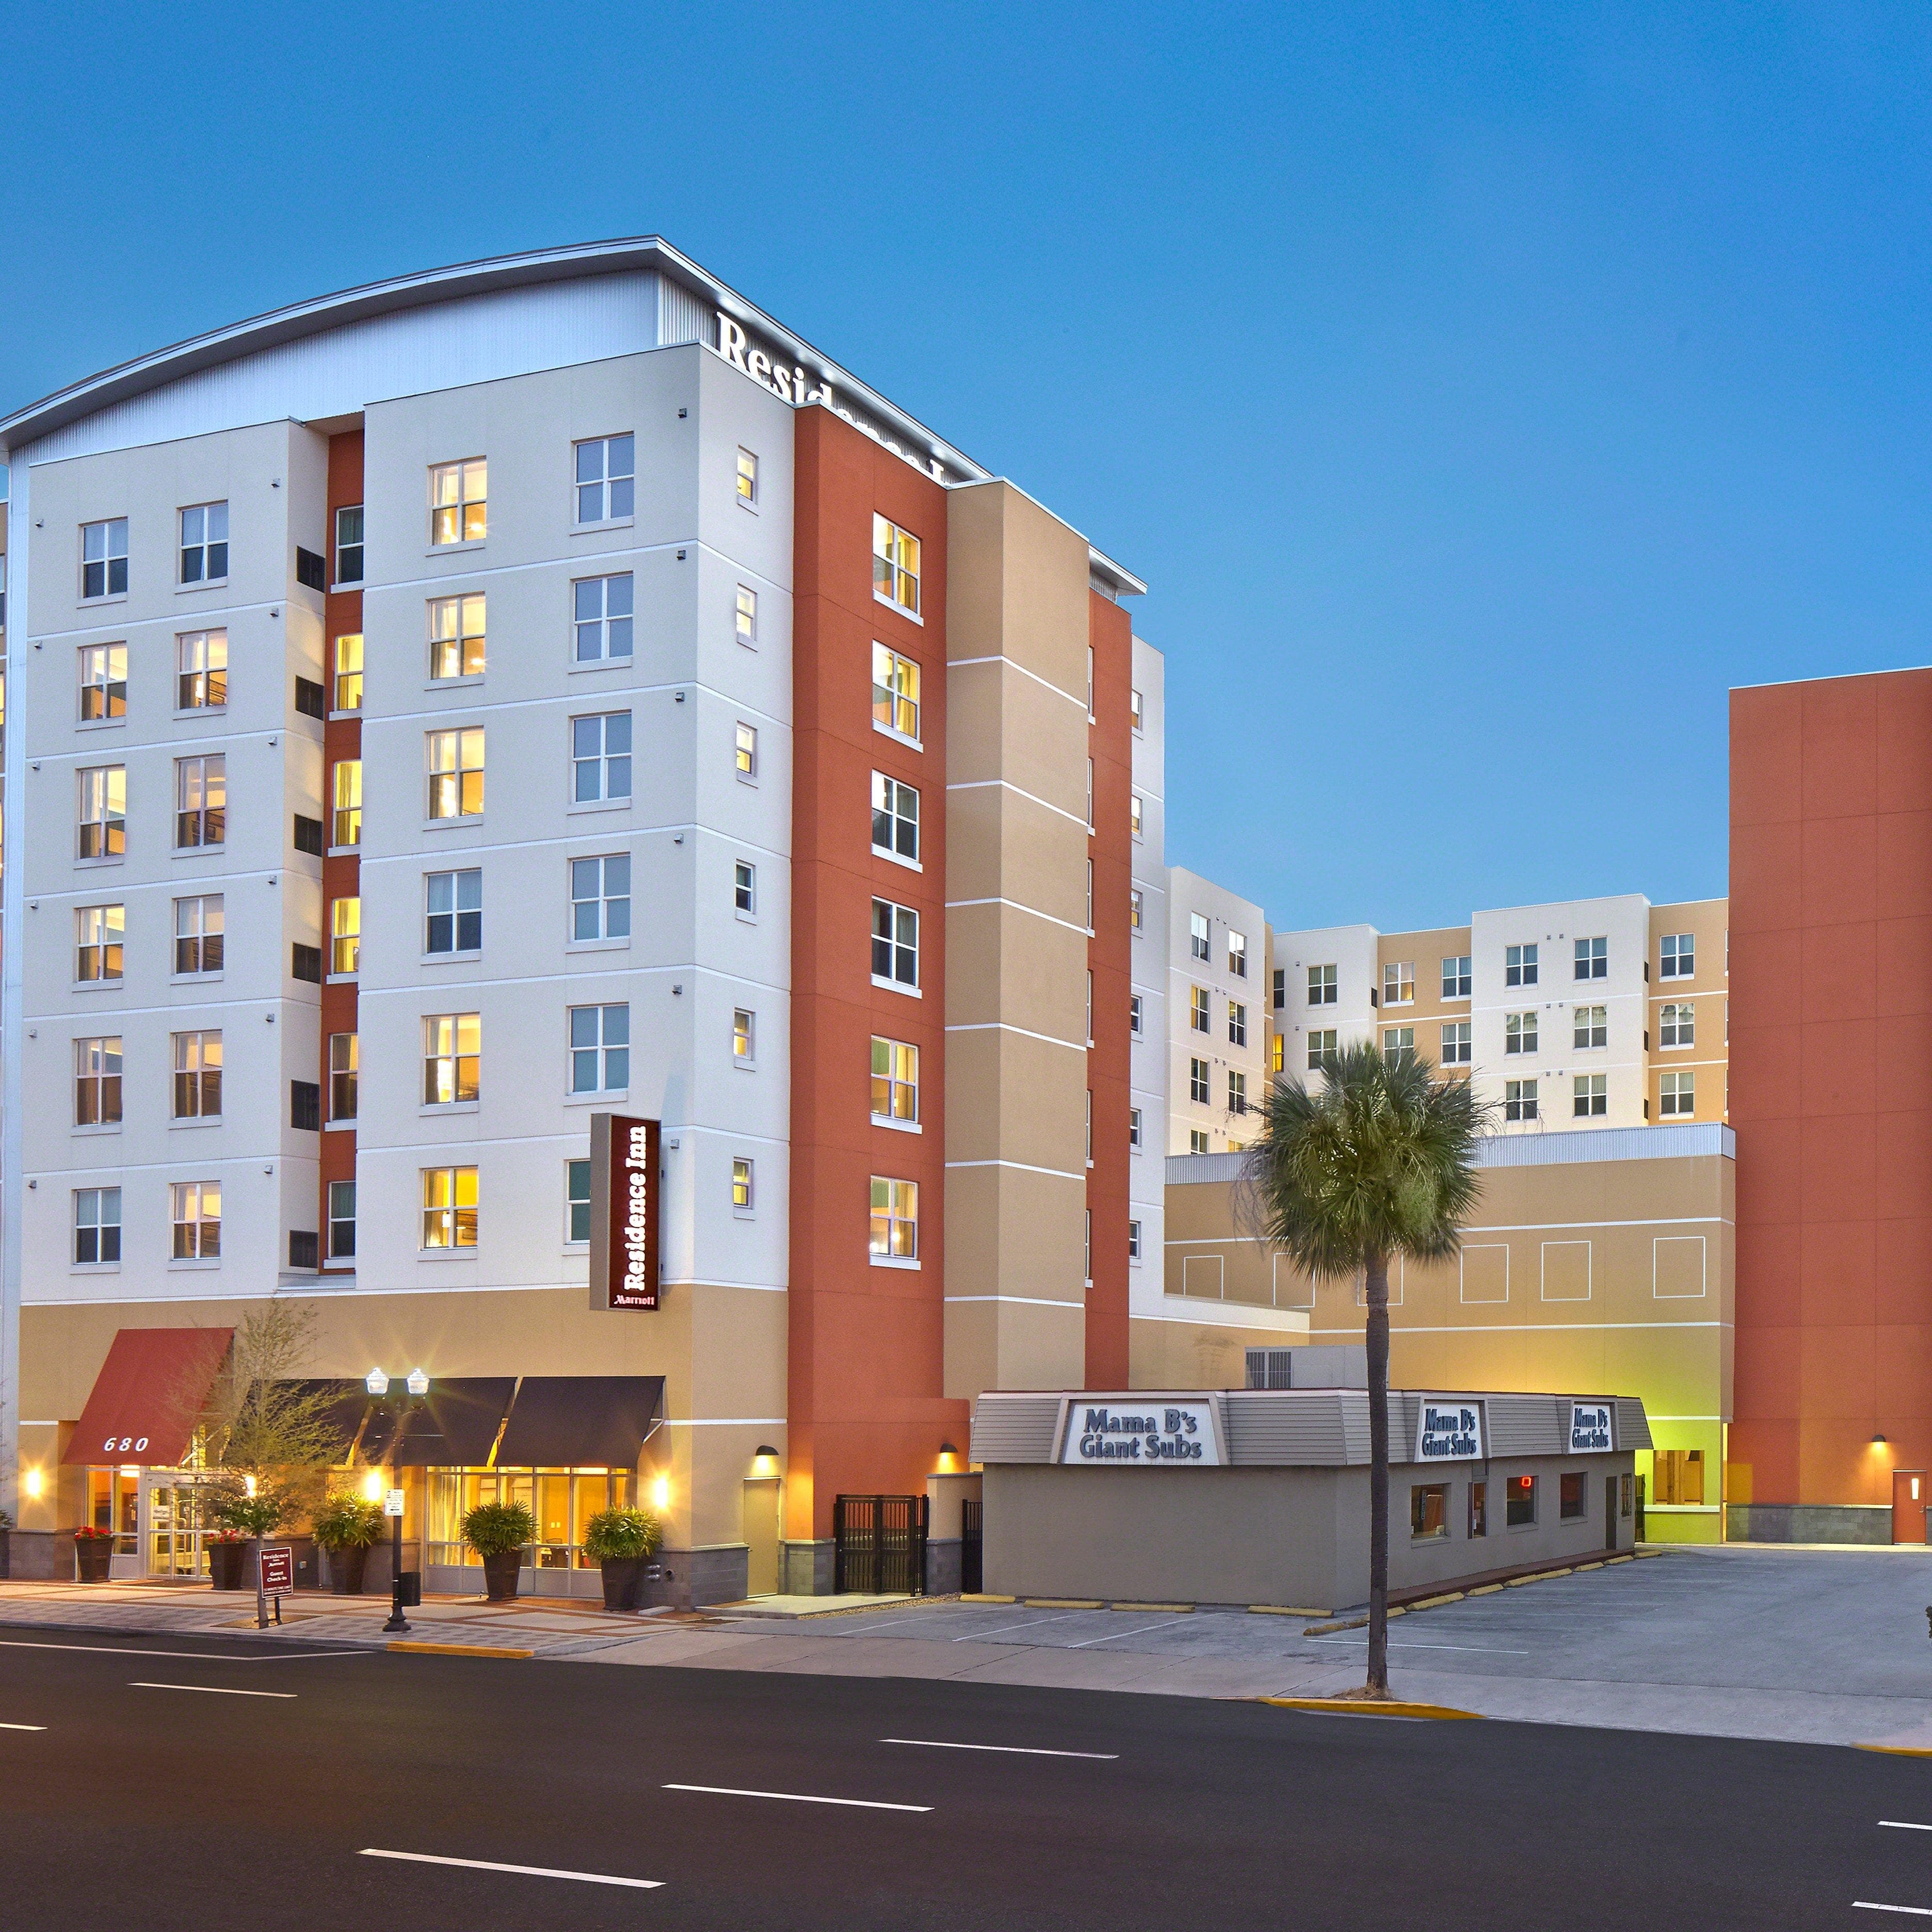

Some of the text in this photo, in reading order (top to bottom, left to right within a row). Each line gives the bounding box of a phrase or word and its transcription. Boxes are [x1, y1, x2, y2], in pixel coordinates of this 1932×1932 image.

[624, 1125, 647, 1292] Residence Inn
[1084, 1409, 1197, 1433] Mama B's
[1425, 1408, 1476, 1431] Mama B's
[1574, 1408, 1608, 1428] Mama B's
[104, 1437, 149, 1452] 680
[1080, 1434, 1202, 1459] Giant Subs
[1422, 1432, 1477, 1455] Giant Subs
[1572, 1428, 1609, 1448] Giant Subs
